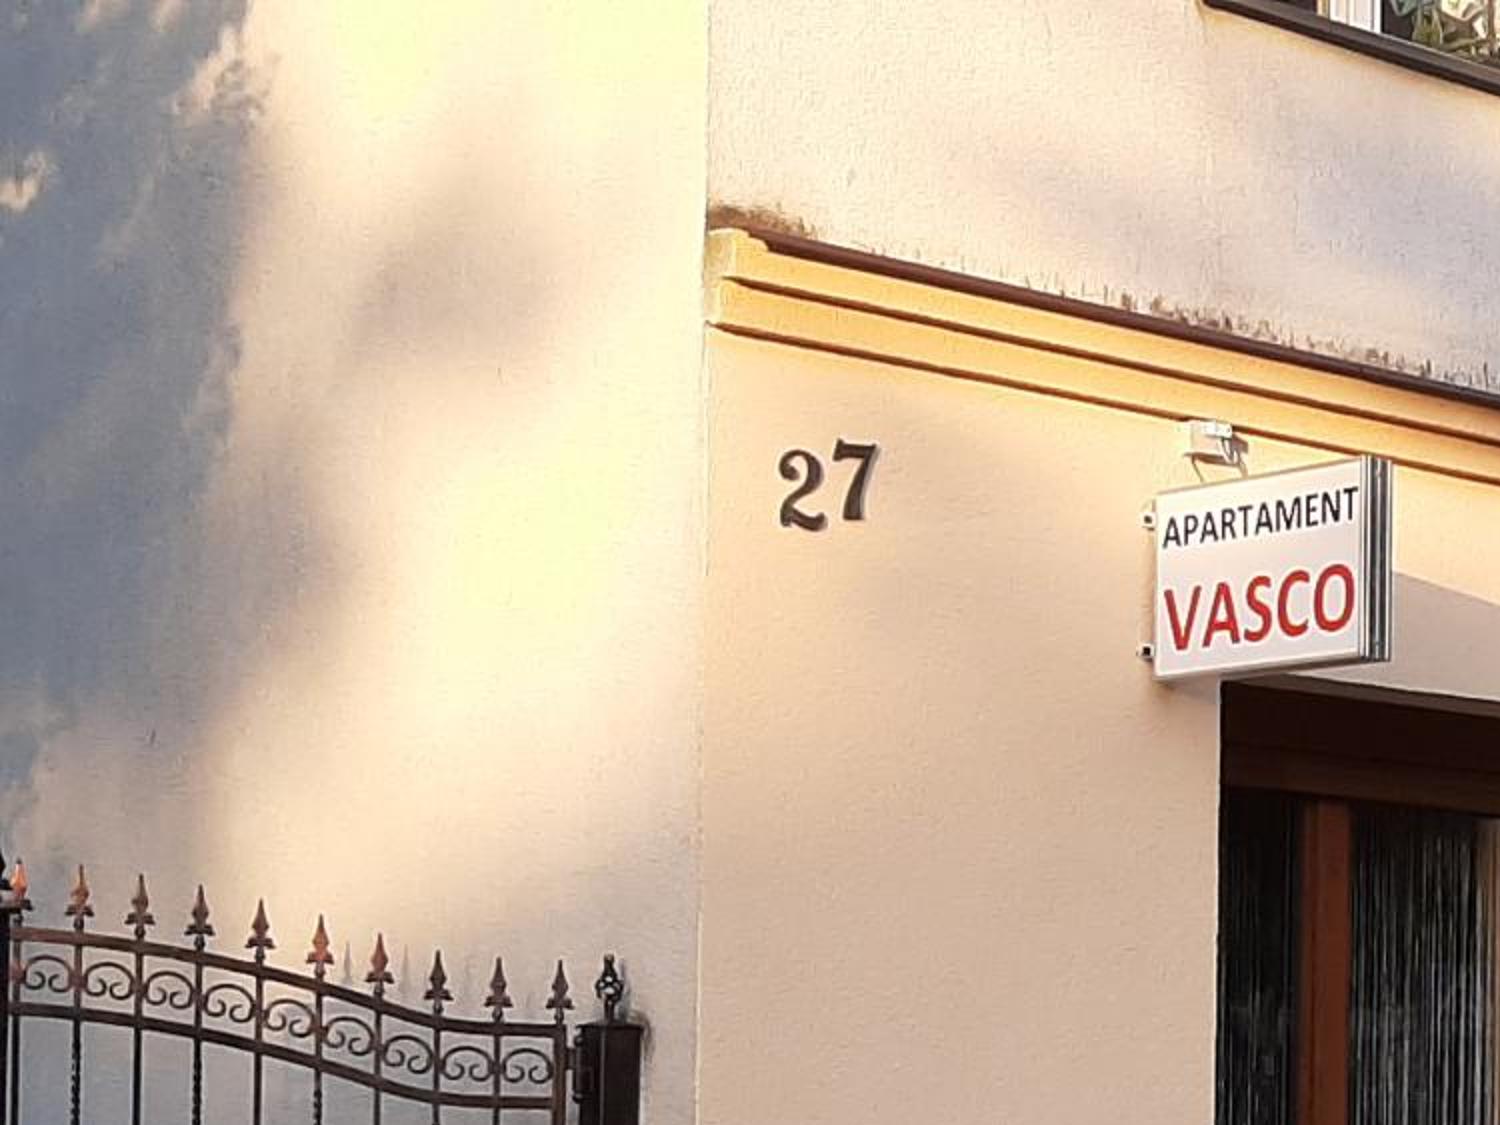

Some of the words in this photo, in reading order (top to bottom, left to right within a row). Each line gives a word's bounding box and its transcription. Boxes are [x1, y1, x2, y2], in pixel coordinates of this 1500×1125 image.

[779, 437, 879, 532] 27
[1162, 486, 1359, 549] APARTAMENT
[1163, 563, 1355, 651] VASCO
